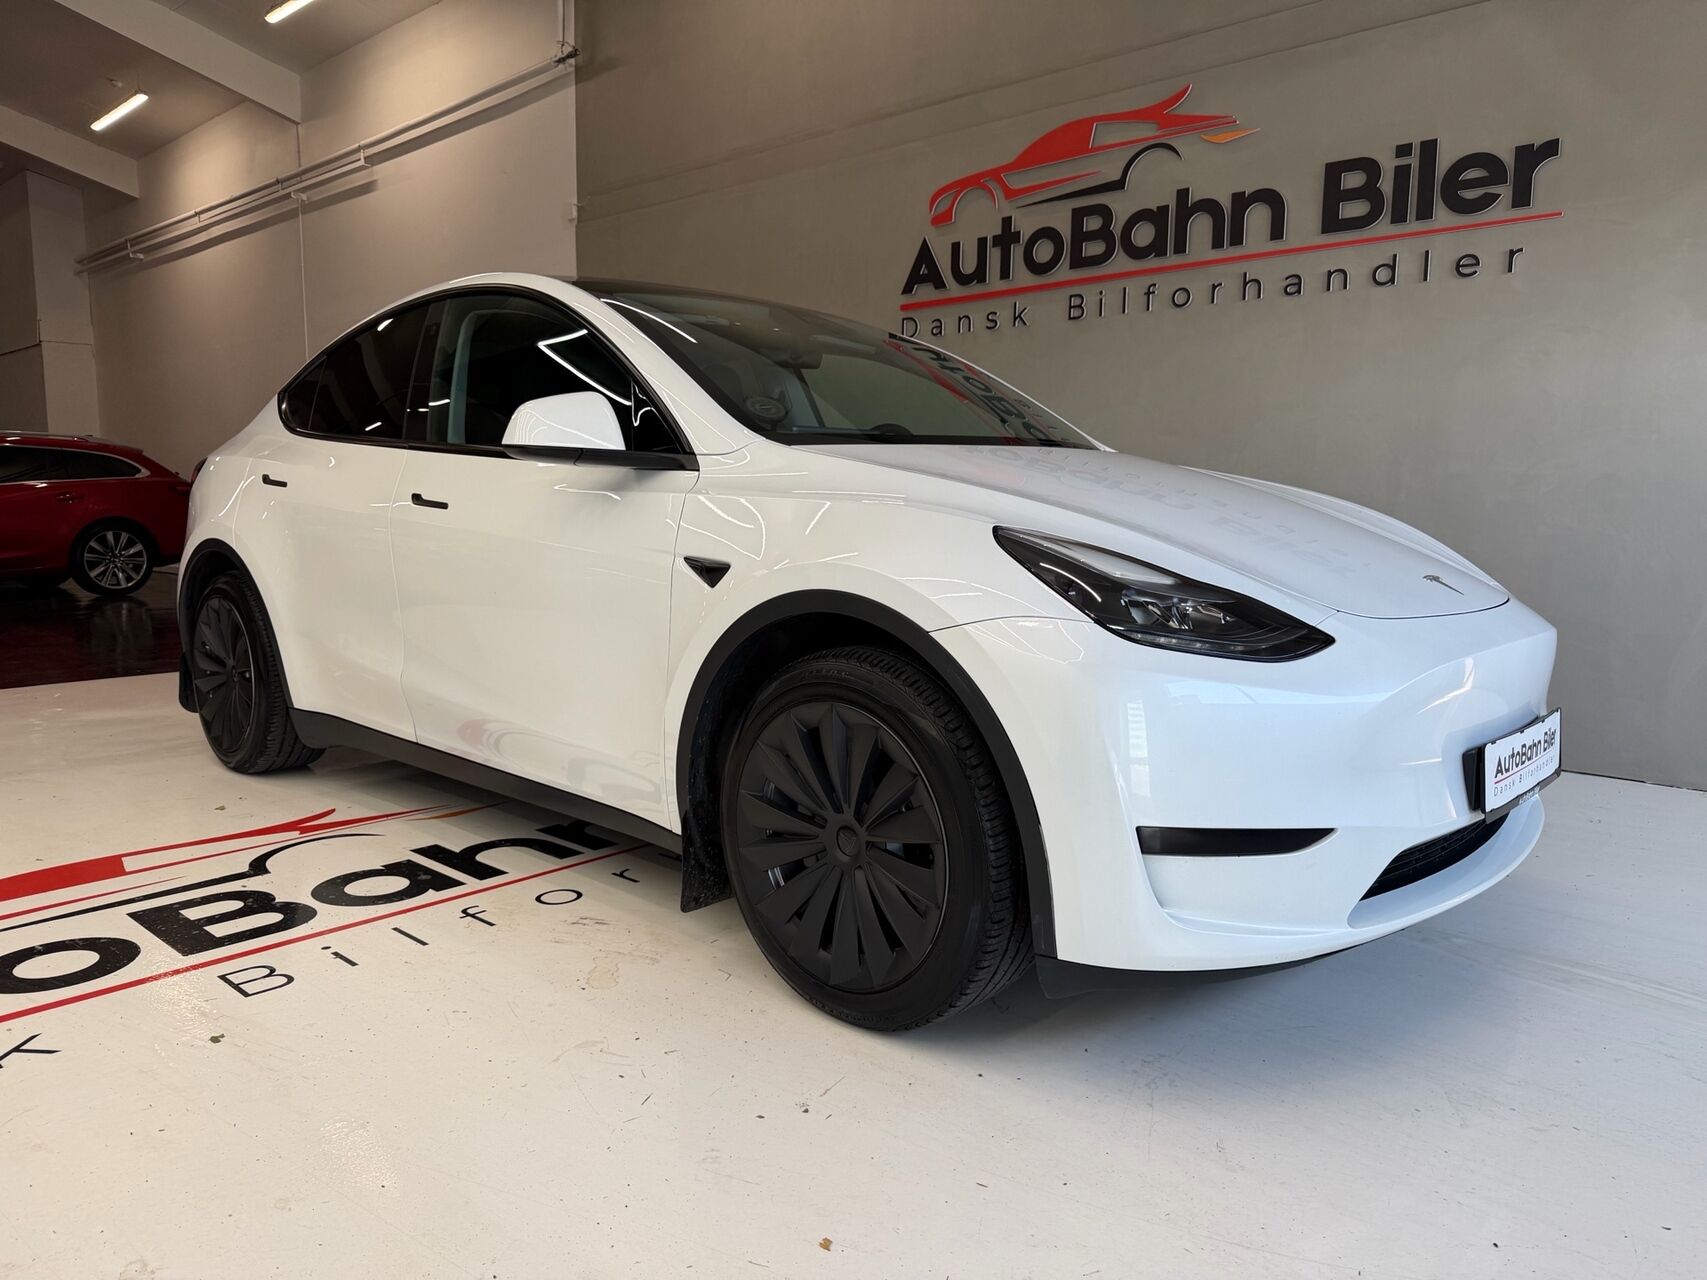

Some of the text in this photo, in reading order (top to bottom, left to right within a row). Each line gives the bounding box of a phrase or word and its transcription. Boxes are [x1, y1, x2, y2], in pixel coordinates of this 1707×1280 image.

[901, 137, 1562, 296] AutoBahn Biler
[901, 244, 1525, 339] Dansk Bilforhandler
[1494, 728, 1557, 778] AutoBahn Biler
